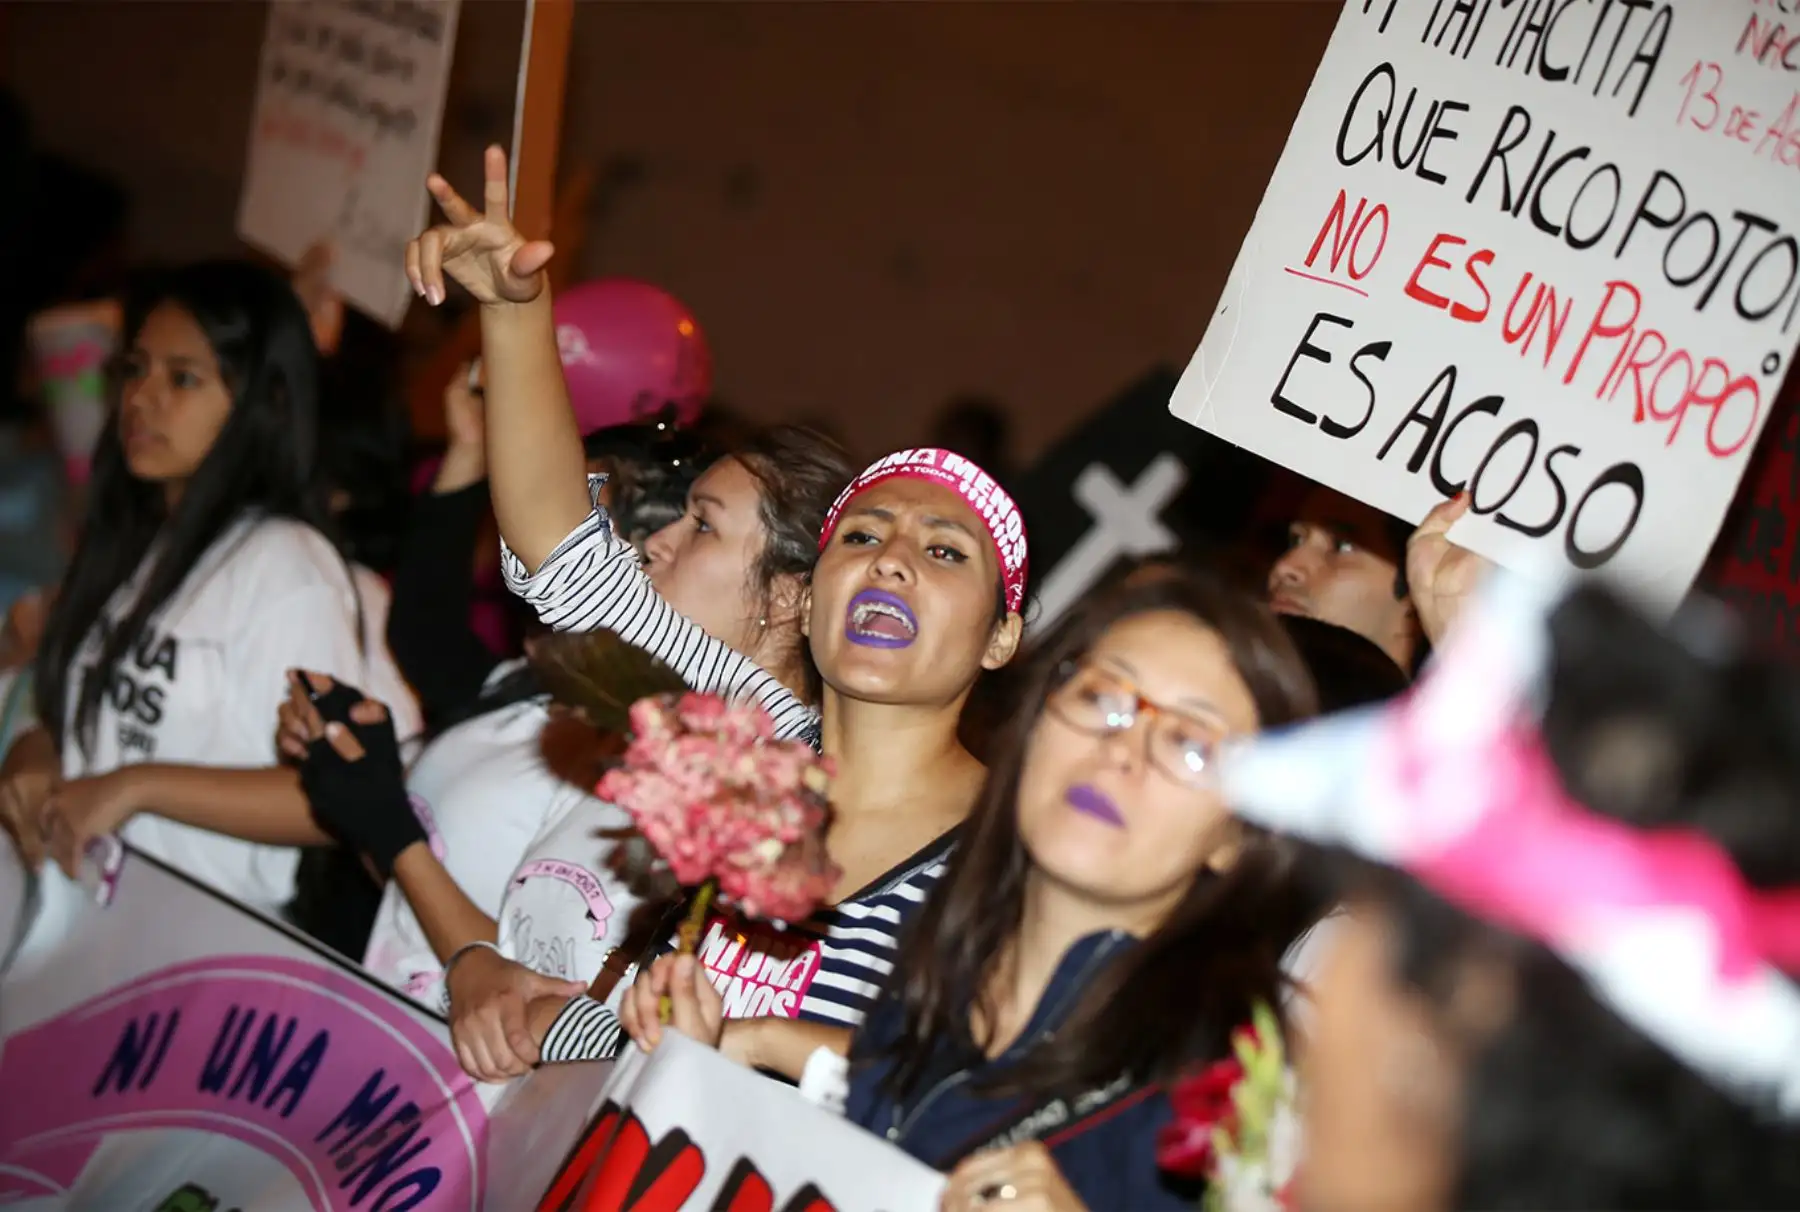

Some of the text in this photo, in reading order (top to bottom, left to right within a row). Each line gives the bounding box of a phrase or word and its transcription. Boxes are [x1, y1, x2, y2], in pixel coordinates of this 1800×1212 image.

[1335, 62, 1470, 184] QUE
[1466, 105, 1622, 250] RICO
[1676, 60, 1722, 131] 13
[1723, 105, 1761, 142] DE
[1304, 189, 1389, 281] NO
[1404, 233, 1495, 324] ES
[1502, 272, 1573, 370] UN
[1562, 280, 1760, 458] PIROPO
[1270, 312, 1392, 440] ES
[1375, 364, 1645, 570] ACOSO
[942, 453, 1027, 569] MENOS
[698, 922, 817, 992] NI UNA
[704, 967, 796, 1019] NOS
[92, 1005, 181, 1097] NI
[198, 1004, 330, 1119] UNA
